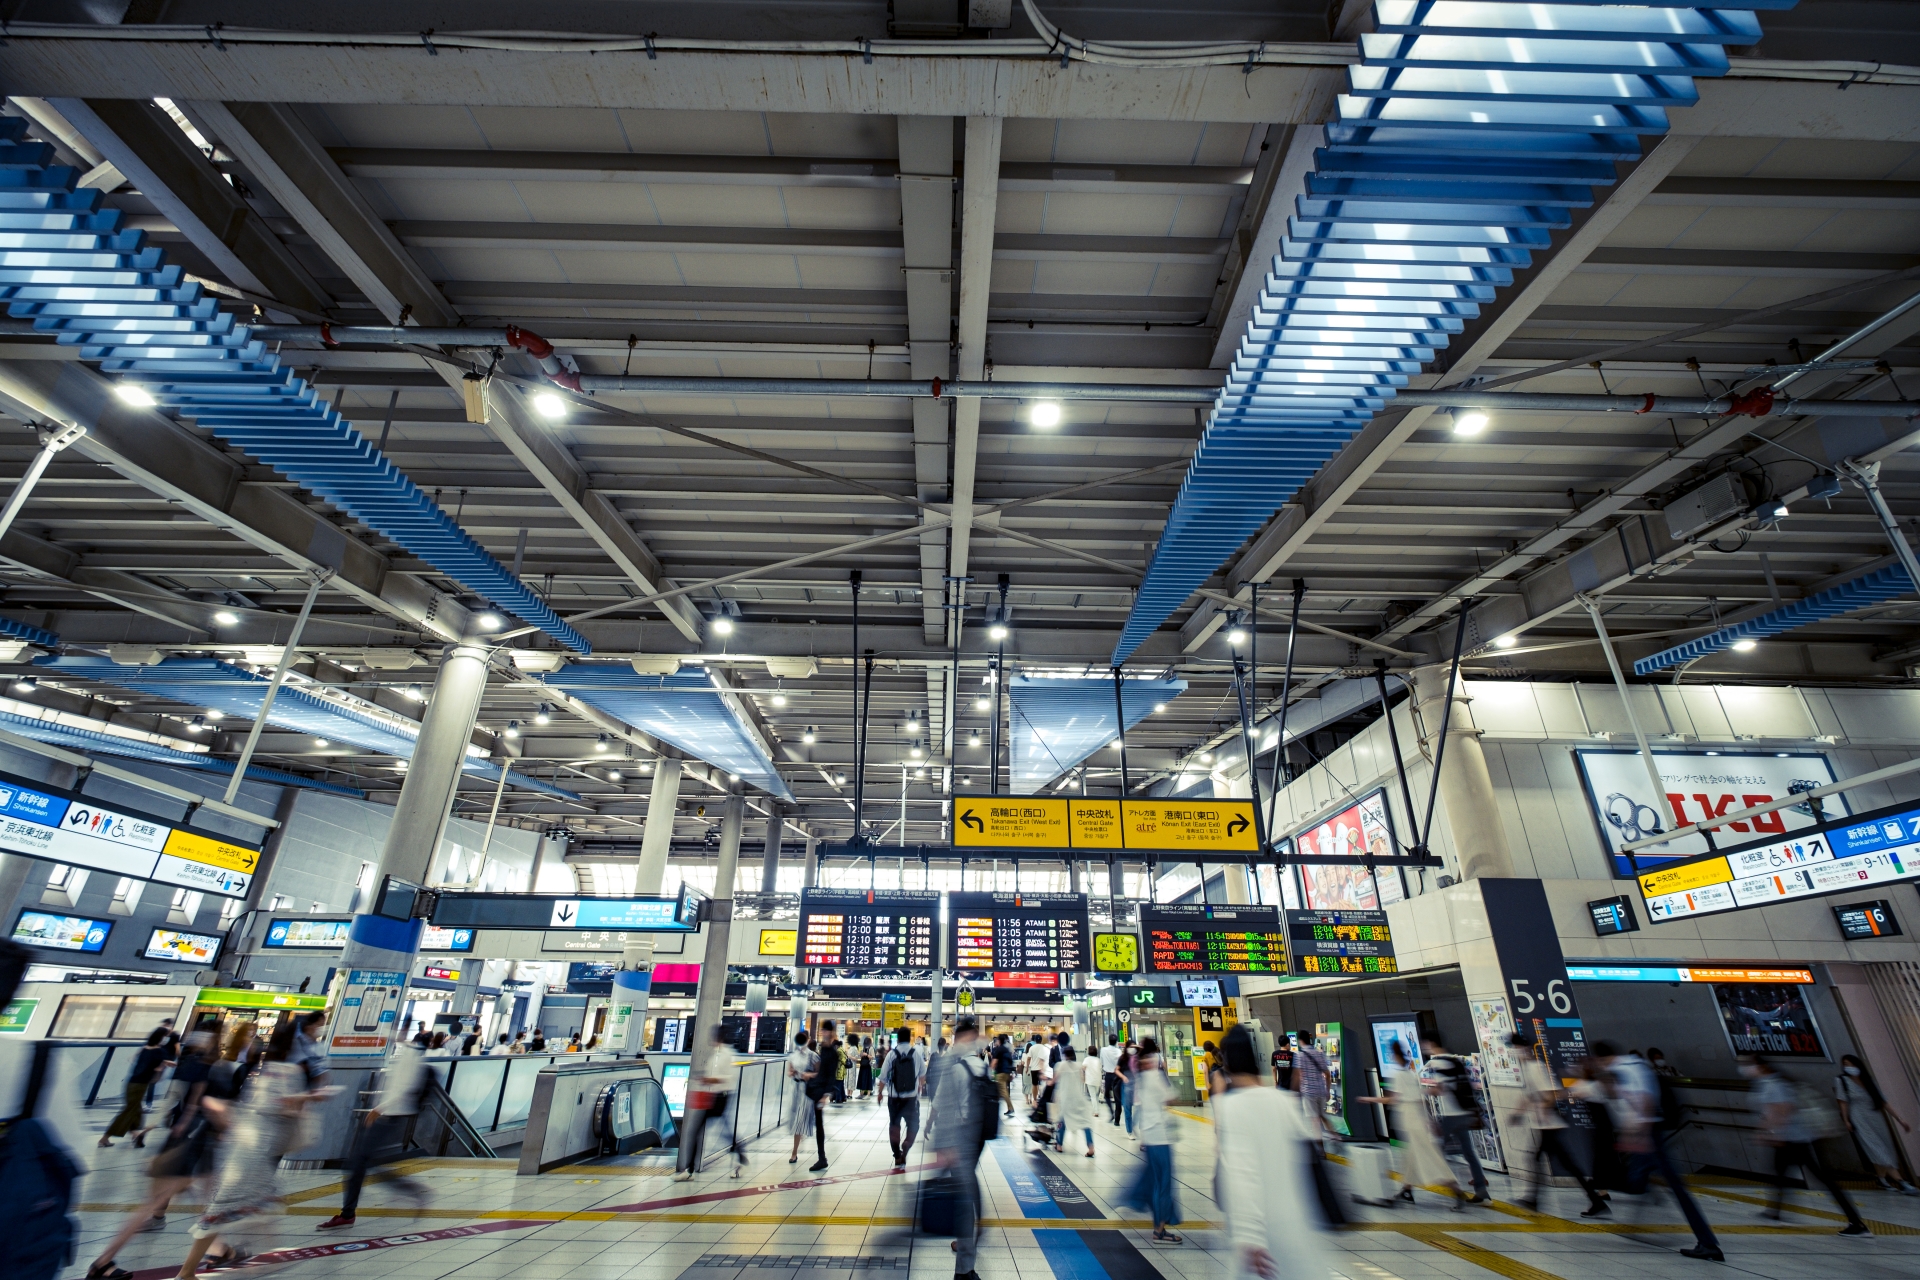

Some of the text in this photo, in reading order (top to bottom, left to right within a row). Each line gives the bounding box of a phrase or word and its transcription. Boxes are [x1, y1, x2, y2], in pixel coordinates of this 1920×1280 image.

[16, 791, 50, 809] 新幹線
[12, 802, 49, 817] Shinkansen
[990, 808, 1046, 818] 高輪口(西口)
[1076, 809, 1115, 819] 中央改札
[1128, 809, 1157, 817] アトレ方面
[1666, 792, 1787, 834] IKO
[1164, 810, 1220, 821] 港南口(東口)
[990, 818, 1018, 826] Takanawa
[1031, 819, 1047, 827] (West
[1049, 820, 1061, 828] Exit)
[1077, 819, 1099, 827] Central
[1208, 821, 1221, 829] Exit)
[4, 821, 55, 842] 京浜東北線
[131, 822, 157, 837] 化粧室
[1846, 824, 1879, 840] 新幹線
[128, 832, 154, 844] Restrooms
[1846, 836, 1883, 849] Shinkansen
[37, 841, 49, 850] Line
[217, 846, 242, 860] 中央改札
[1740, 851, 1765, 864] 化粧室
[216, 855, 239, 866] Central Gate
[183, 863, 219, 878] 京浜東北線
[1742, 861, 1768, 872] Restrooms
[216, 872, 227, 886] 4
[1655, 871, 1681, 883] 中央改札
[1794, 871, 1803, 881] 8
[1860, 871, 1866, 879] 9
[1657, 880, 1682, 890] Central Gate
[1766, 877, 1773, 887] 7
[1668, 897, 1675, 906] 5
[1692, 892, 1698, 902] 6
[1615, 904, 1625, 918] 5
[1873, 908, 1885, 923] 6
[848, 916, 872, 924] 11:50
[910, 917, 931, 925] 6番線
[997, 918, 1022, 927] 11:56
[847, 926, 871, 934] 12:00
[910, 927, 930, 935] 6番線
[997, 928, 1022, 937] 12:05
[847, 936, 930, 945] 12:10 宇都宮 6番線
[1206, 932, 1226, 940] 11:54
[1265, 933, 1273, 941] 11
[1373, 933, 1381, 941] 13
[565, 941, 586, 949] Central
[997, 938, 1022, 947] 12:08
[1207, 942, 1227, 950] 12:15
[1267, 943, 1274, 951] 9
[846, 946, 870, 954] 12:20
[909, 947, 930, 955] 6番線
[997, 948, 1022, 957] 12:16
[845, 956, 869, 964] 12:25
[873, 957, 889, 965] 東京
[909, 957, 930, 966] 6番線
[1153, 951, 1175, 960] RAPID
[1208, 952, 1228, 960] 12:17
[1268, 953, 1276, 961] 10
[1318, 956, 1337, 964] 12:01
[1377, 957, 1386, 965] 15
[997, 958, 1022, 967] 12:27
[1228, 962, 1250, 971] SENDAI
[1270, 963, 1277, 971] 9
[1802, 972, 1811, 982] 6
[272, 996, 301, 1006] NewDays
[1134, 990, 1155, 1004] JR
[1733, 1033, 1819, 1053] BUCK-TICK 9.21
